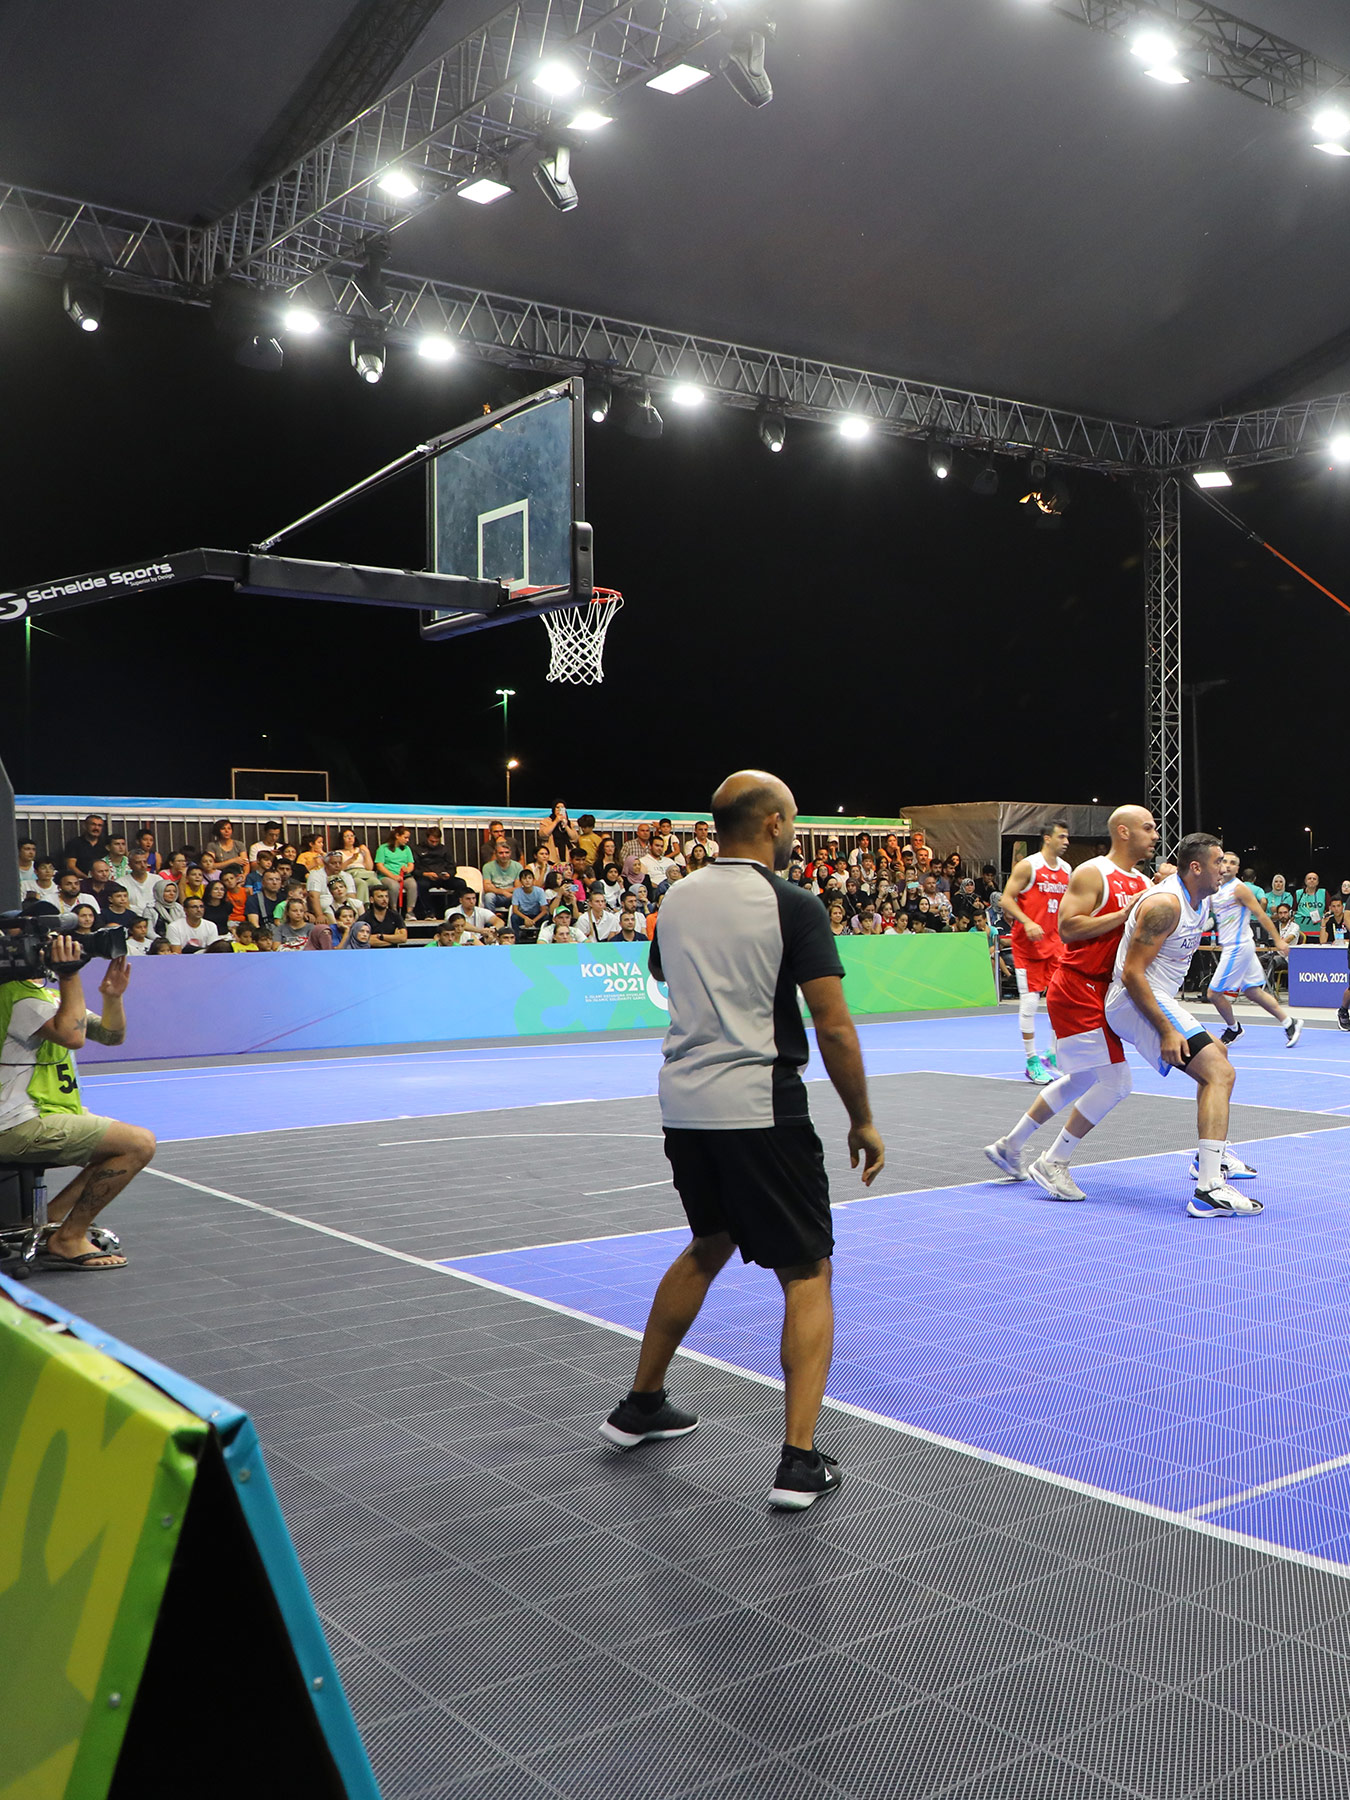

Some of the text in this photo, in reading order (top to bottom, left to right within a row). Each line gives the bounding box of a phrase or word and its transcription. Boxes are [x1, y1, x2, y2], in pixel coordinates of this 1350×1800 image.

[26, 562, 173, 603] Schelde Sports
[157, 573, 176, 581] Design
[1301, 915, 1318, 925] 77
[580, 962, 642, 978] KONYA
[1299, 972, 1348, 983] KONYA 2021
[603, 977, 645, 993] 2021
